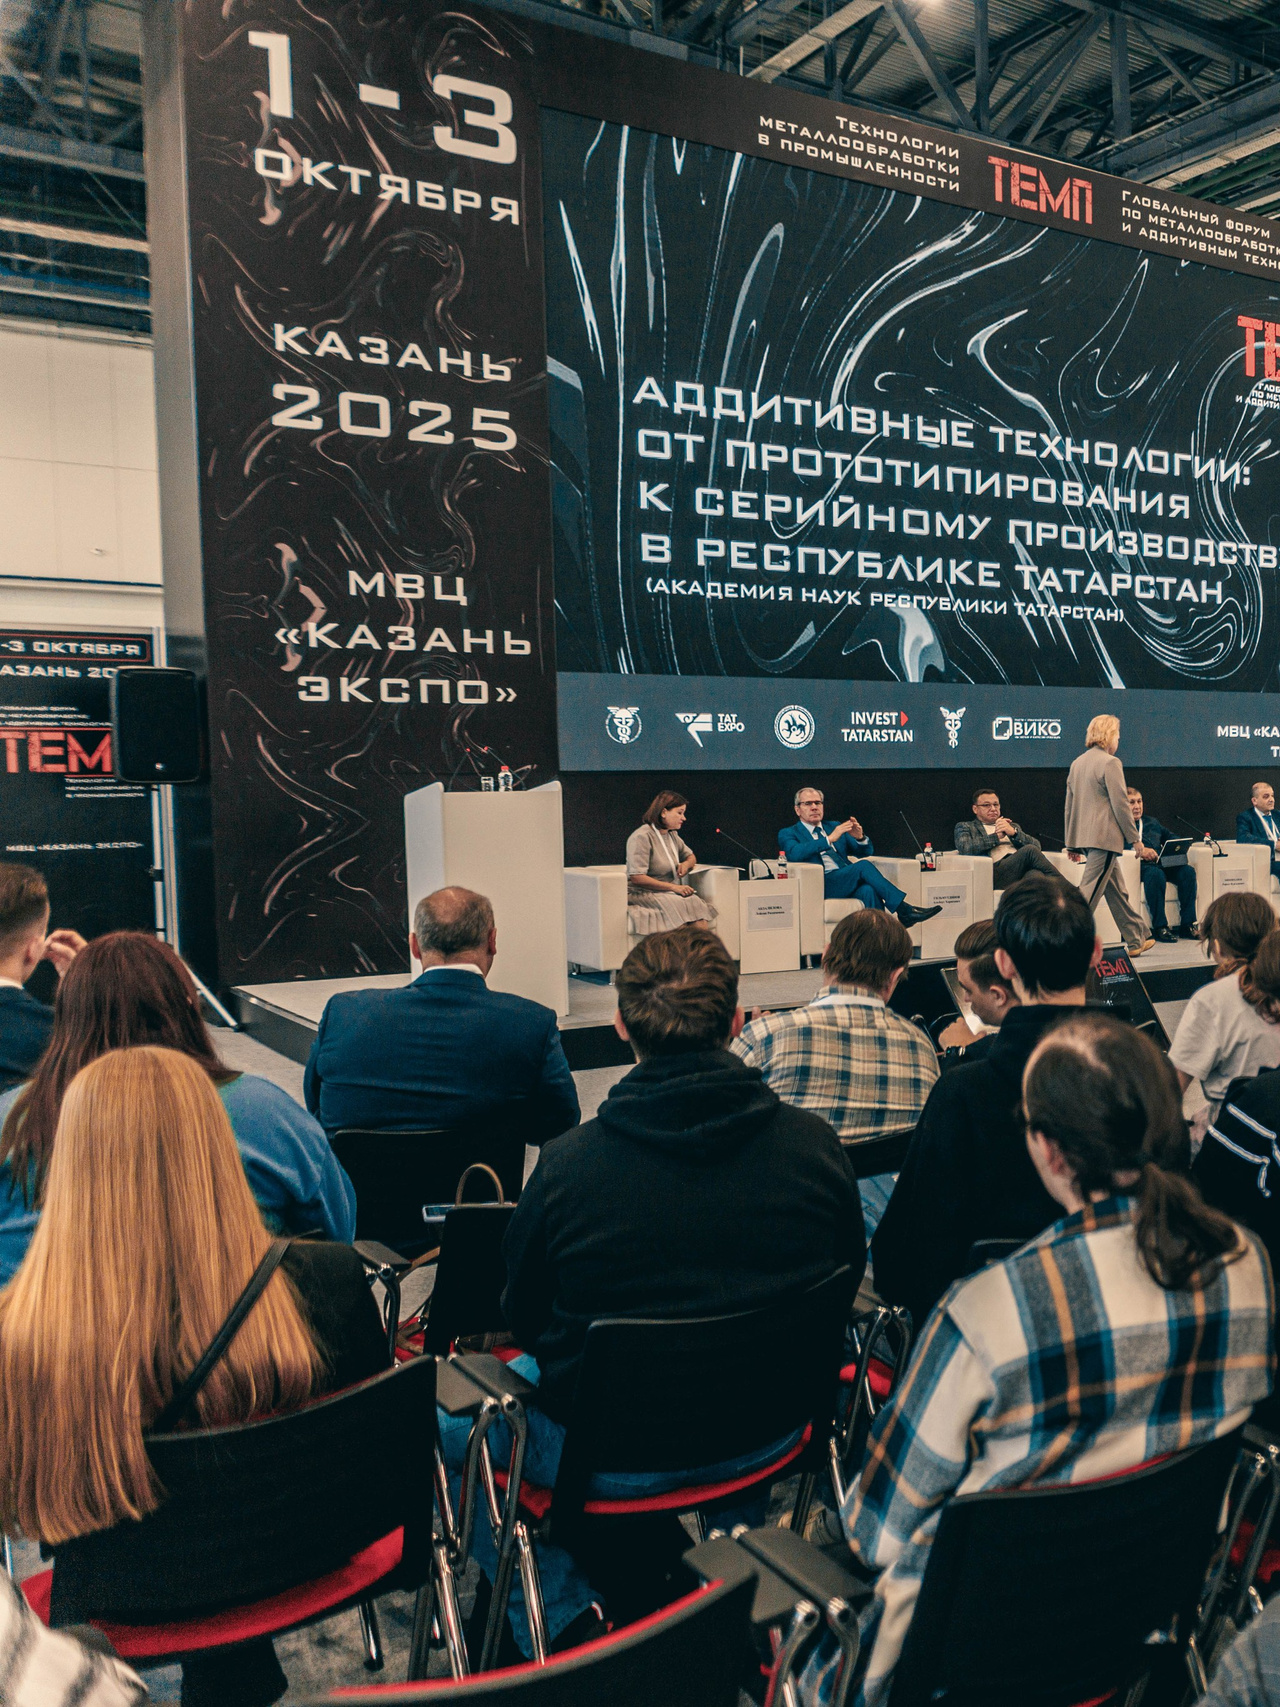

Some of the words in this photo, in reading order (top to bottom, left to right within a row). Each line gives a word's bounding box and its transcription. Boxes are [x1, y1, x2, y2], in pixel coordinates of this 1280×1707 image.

[247, 31, 294, 119] 1
[432, 74, 518, 164] 3
[759, 115, 960, 176] МЕТАЛЛООБРАБОТКИ
[835, 115, 960, 159] ТЕХНОЛОГИИ
[758, 133, 770, 146] В
[780, 138, 960, 192] ПРОМЫШЛЕННОСТИ
[255, 148, 520, 225] ОКТЯБРЯ
[987, 155, 1093, 224] ТЕМП
[1122, 206, 1141, 220] ПО
[1122, 190, 1219, 225] ГЛОБАЛЬНЫЙ
[1225, 218, 1271, 239] ФОРУМ
[1121, 222, 1132, 233] И
[1138, 227, 1238, 259] АДДИТИВНЫМ
[273, 323, 512, 382] КАЗАНЬ
[1235, 395, 1243, 403] И
[1252, 390, 1264, 399] ПО
[271, 382, 518, 452] 2025
[633, 376, 975, 449] АДДИТИВНЫЕ
[988, 425, 1251, 487] ТЕХНОЛОГИИ:
[637, 428, 705, 463] ОТ
[726, 438, 1191, 520] ПРОТОТИПИРОВАНИЯ
[639, 481, 672, 512] К
[694, 486, 992, 541] СЕРИЙНОМУ
[347, 570, 468, 606] МВЦ
[641, 532, 672, 564] В
[697, 537, 1002, 588] РЕСПУБЛИКЕ
[1014, 563, 1223, 605] ТАТАРСТАН
[646, 576, 793, 602] (АКАДЕМИЯ
[801, 587, 862, 606] НАУК
[870, 592, 1008, 616] РЕСПУБЛИКИ
[1013, 601, 1125, 623] ТАТАРСТАН)
[0, 640, 25, 652] -3
[32, 641, 141, 656] ОКТЯБРЯ
[274, 622, 532, 655] «КАЗАНЬ
[0, 664, 81, 678] АЗАНЬ
[87, 667, 118, 678] 20
[297, 676, 518, 704] ЭКСПО»
[717, 713, 738, 723] TAT
[717, 722, 745, 732] EXPO
[841, 728, 914, 743] TATARSTAN
[850, 711, 899, 726] INVEST
[1013, 722, 1062, 736] ВИКО
[1217, 725, 1250, 739] МВЦ
[0, 730, 113, 774] ТЕМ
